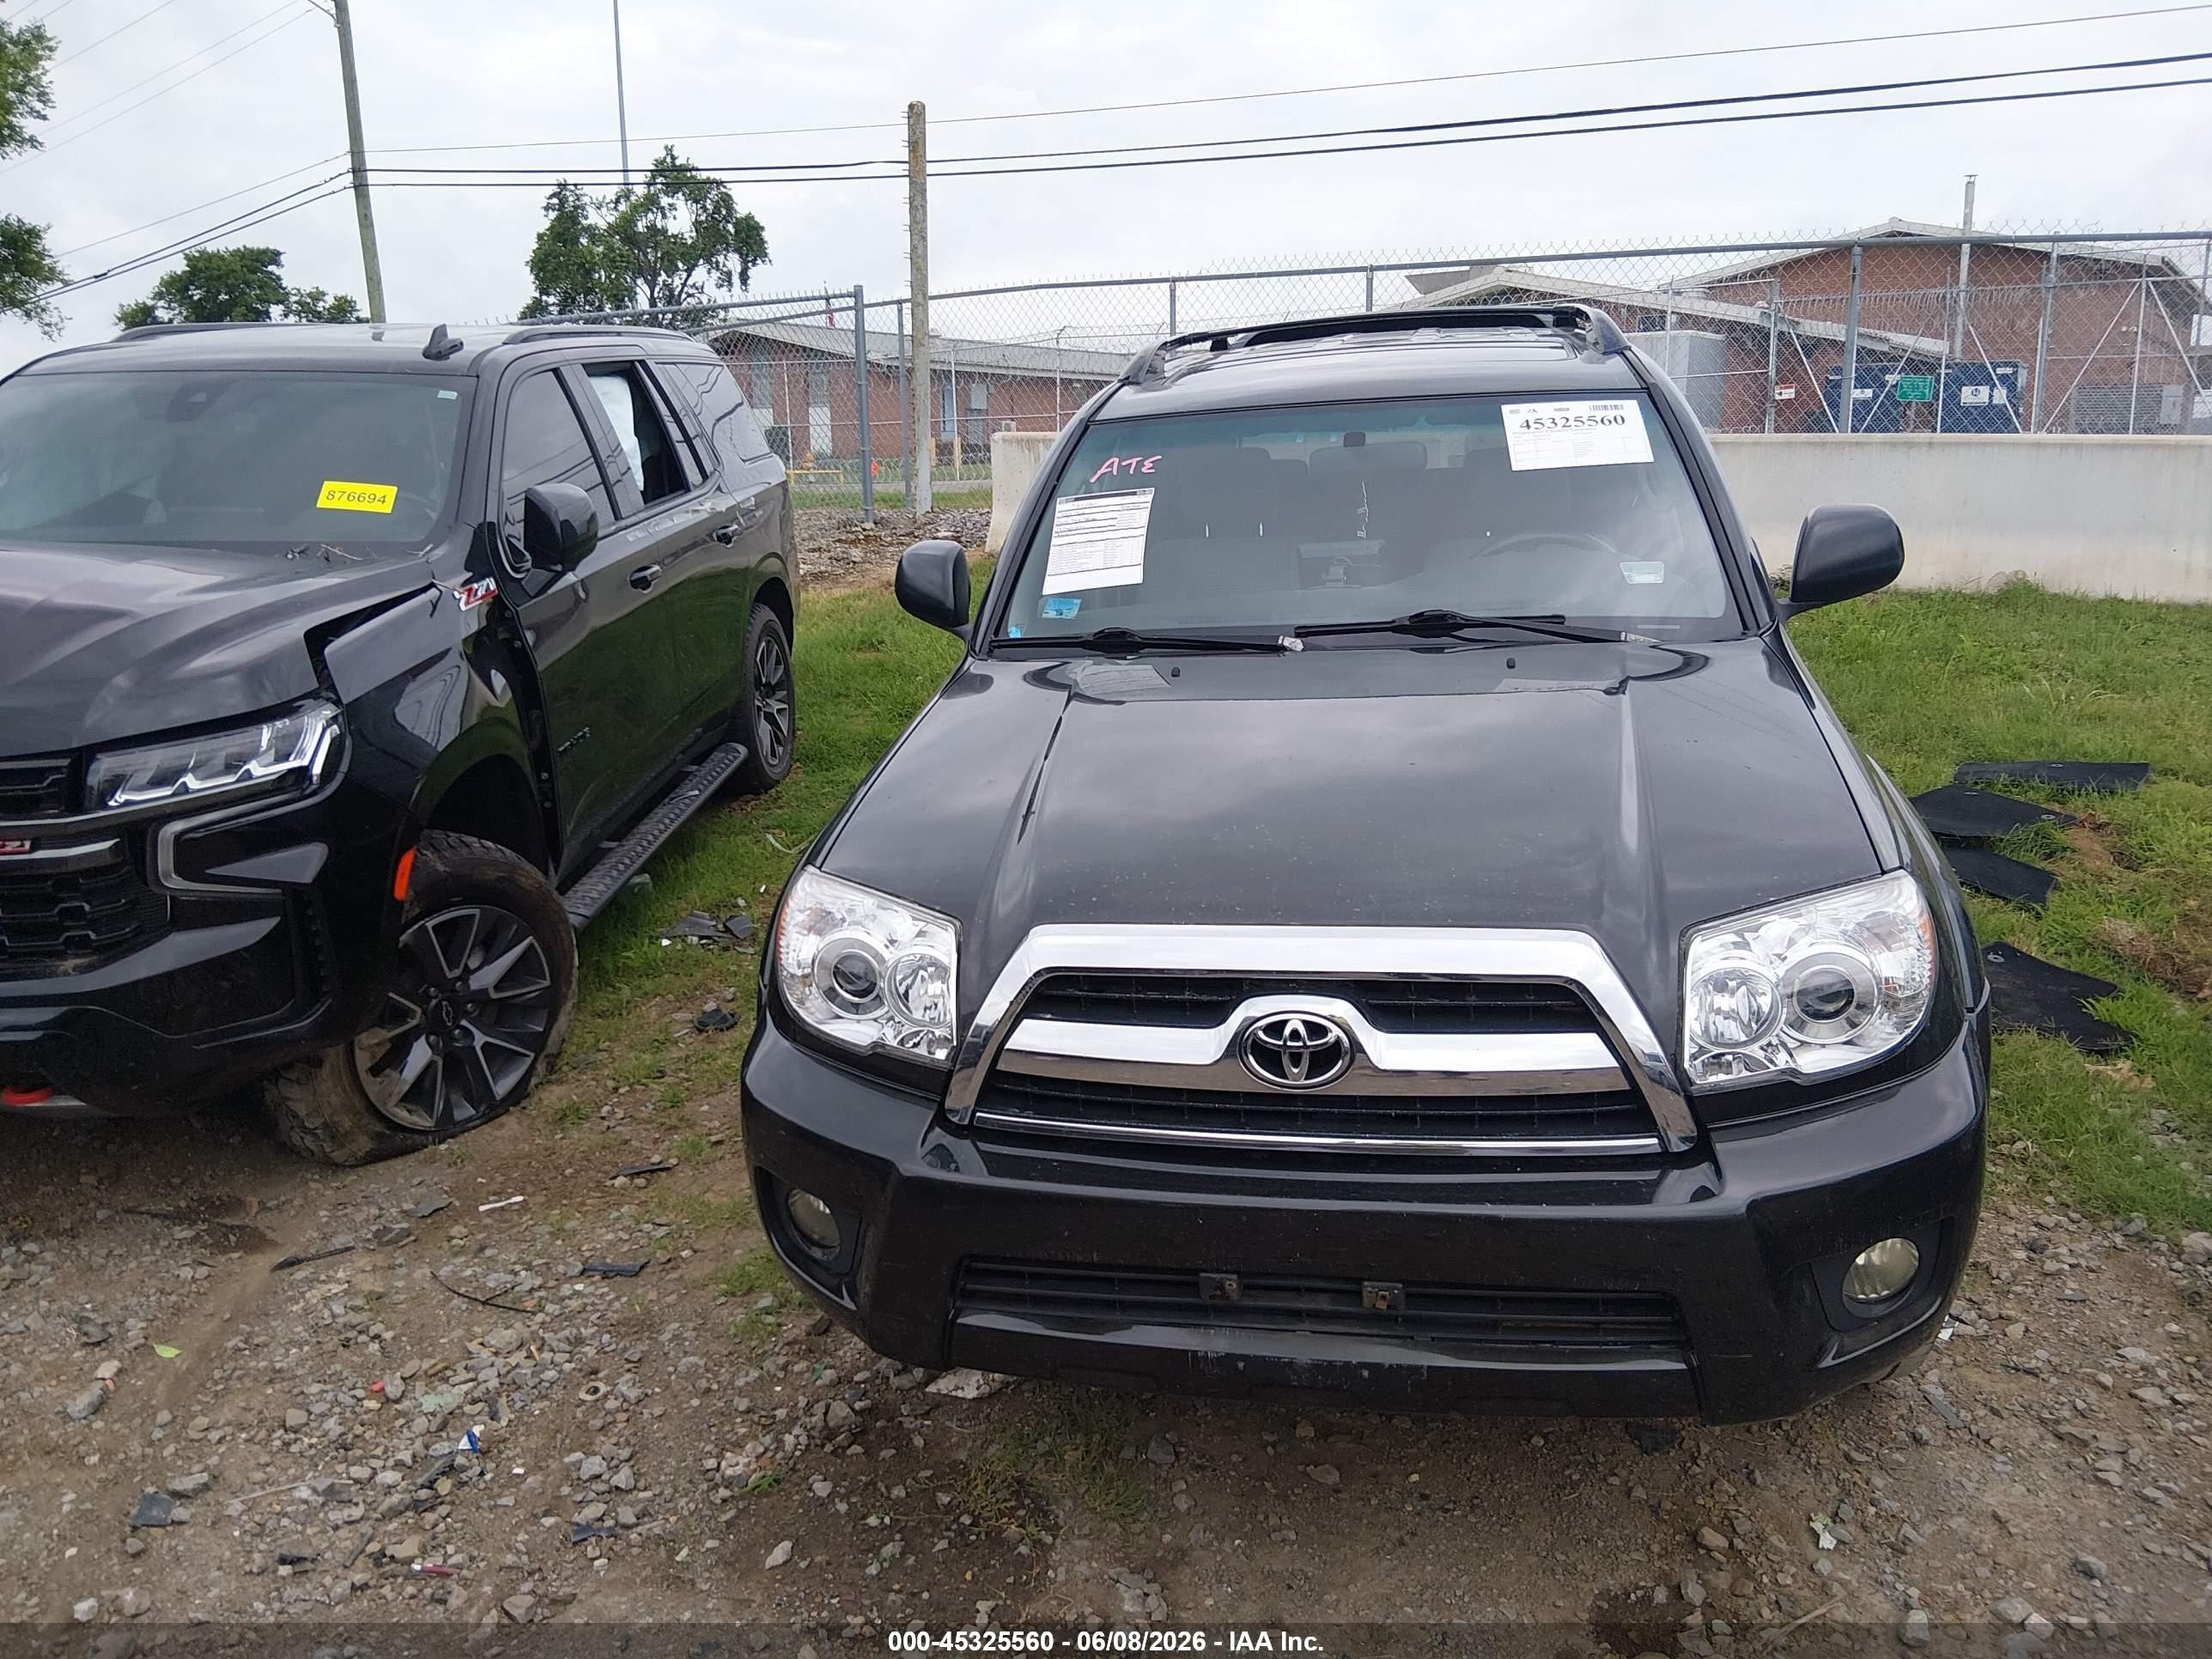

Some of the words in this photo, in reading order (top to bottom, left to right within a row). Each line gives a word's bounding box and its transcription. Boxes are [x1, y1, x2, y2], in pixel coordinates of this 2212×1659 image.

[1519, 414, 1626, 429] 45325560
[1090, 455, 1163, 483] ATE
[325, 489, 387, 505] 876694
[453, 576, 499, 611] Z71
